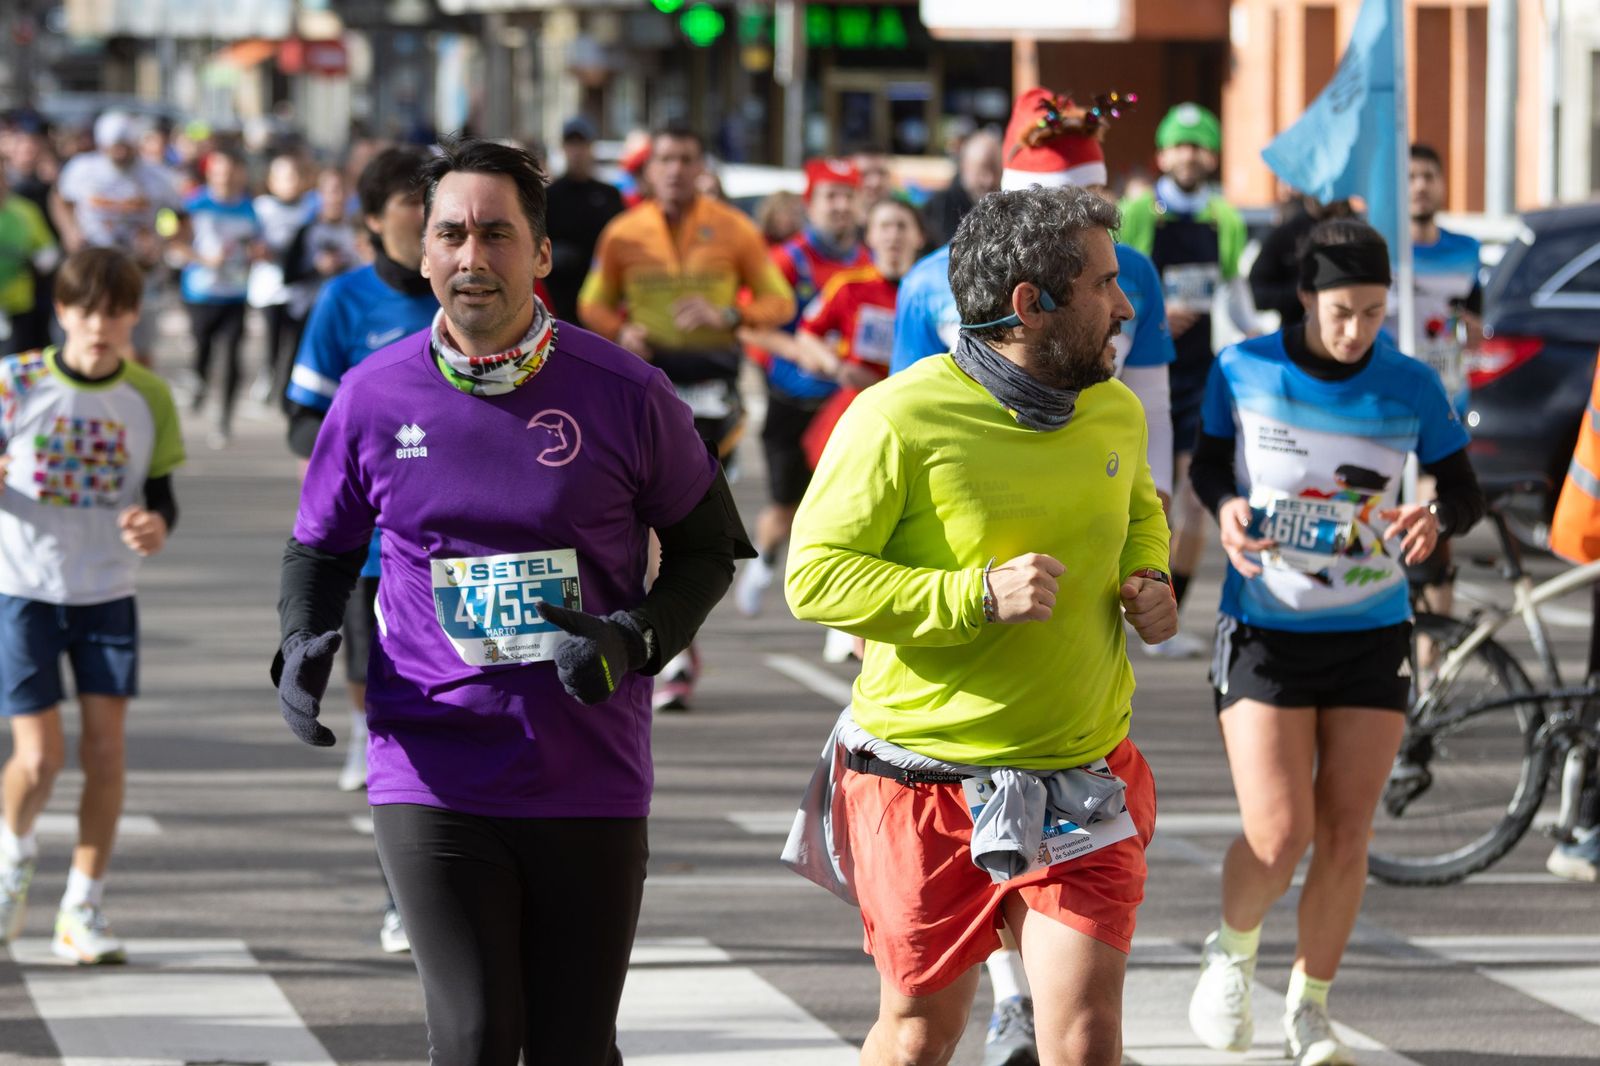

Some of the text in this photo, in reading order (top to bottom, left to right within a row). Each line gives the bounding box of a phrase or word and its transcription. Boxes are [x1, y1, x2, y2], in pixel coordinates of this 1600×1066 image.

[396, 446, 428, 459] errea
[470, 558, 563, 580] SETEL
[455, 581, 546, 630] 4755
[485, 626, 517, 638] MARIO
[924, 774, 964, 783] recovery
[1051, 836, 1090, 853] Ayuntamiento
[1054, 843, 1093, 861] de Salamanca
